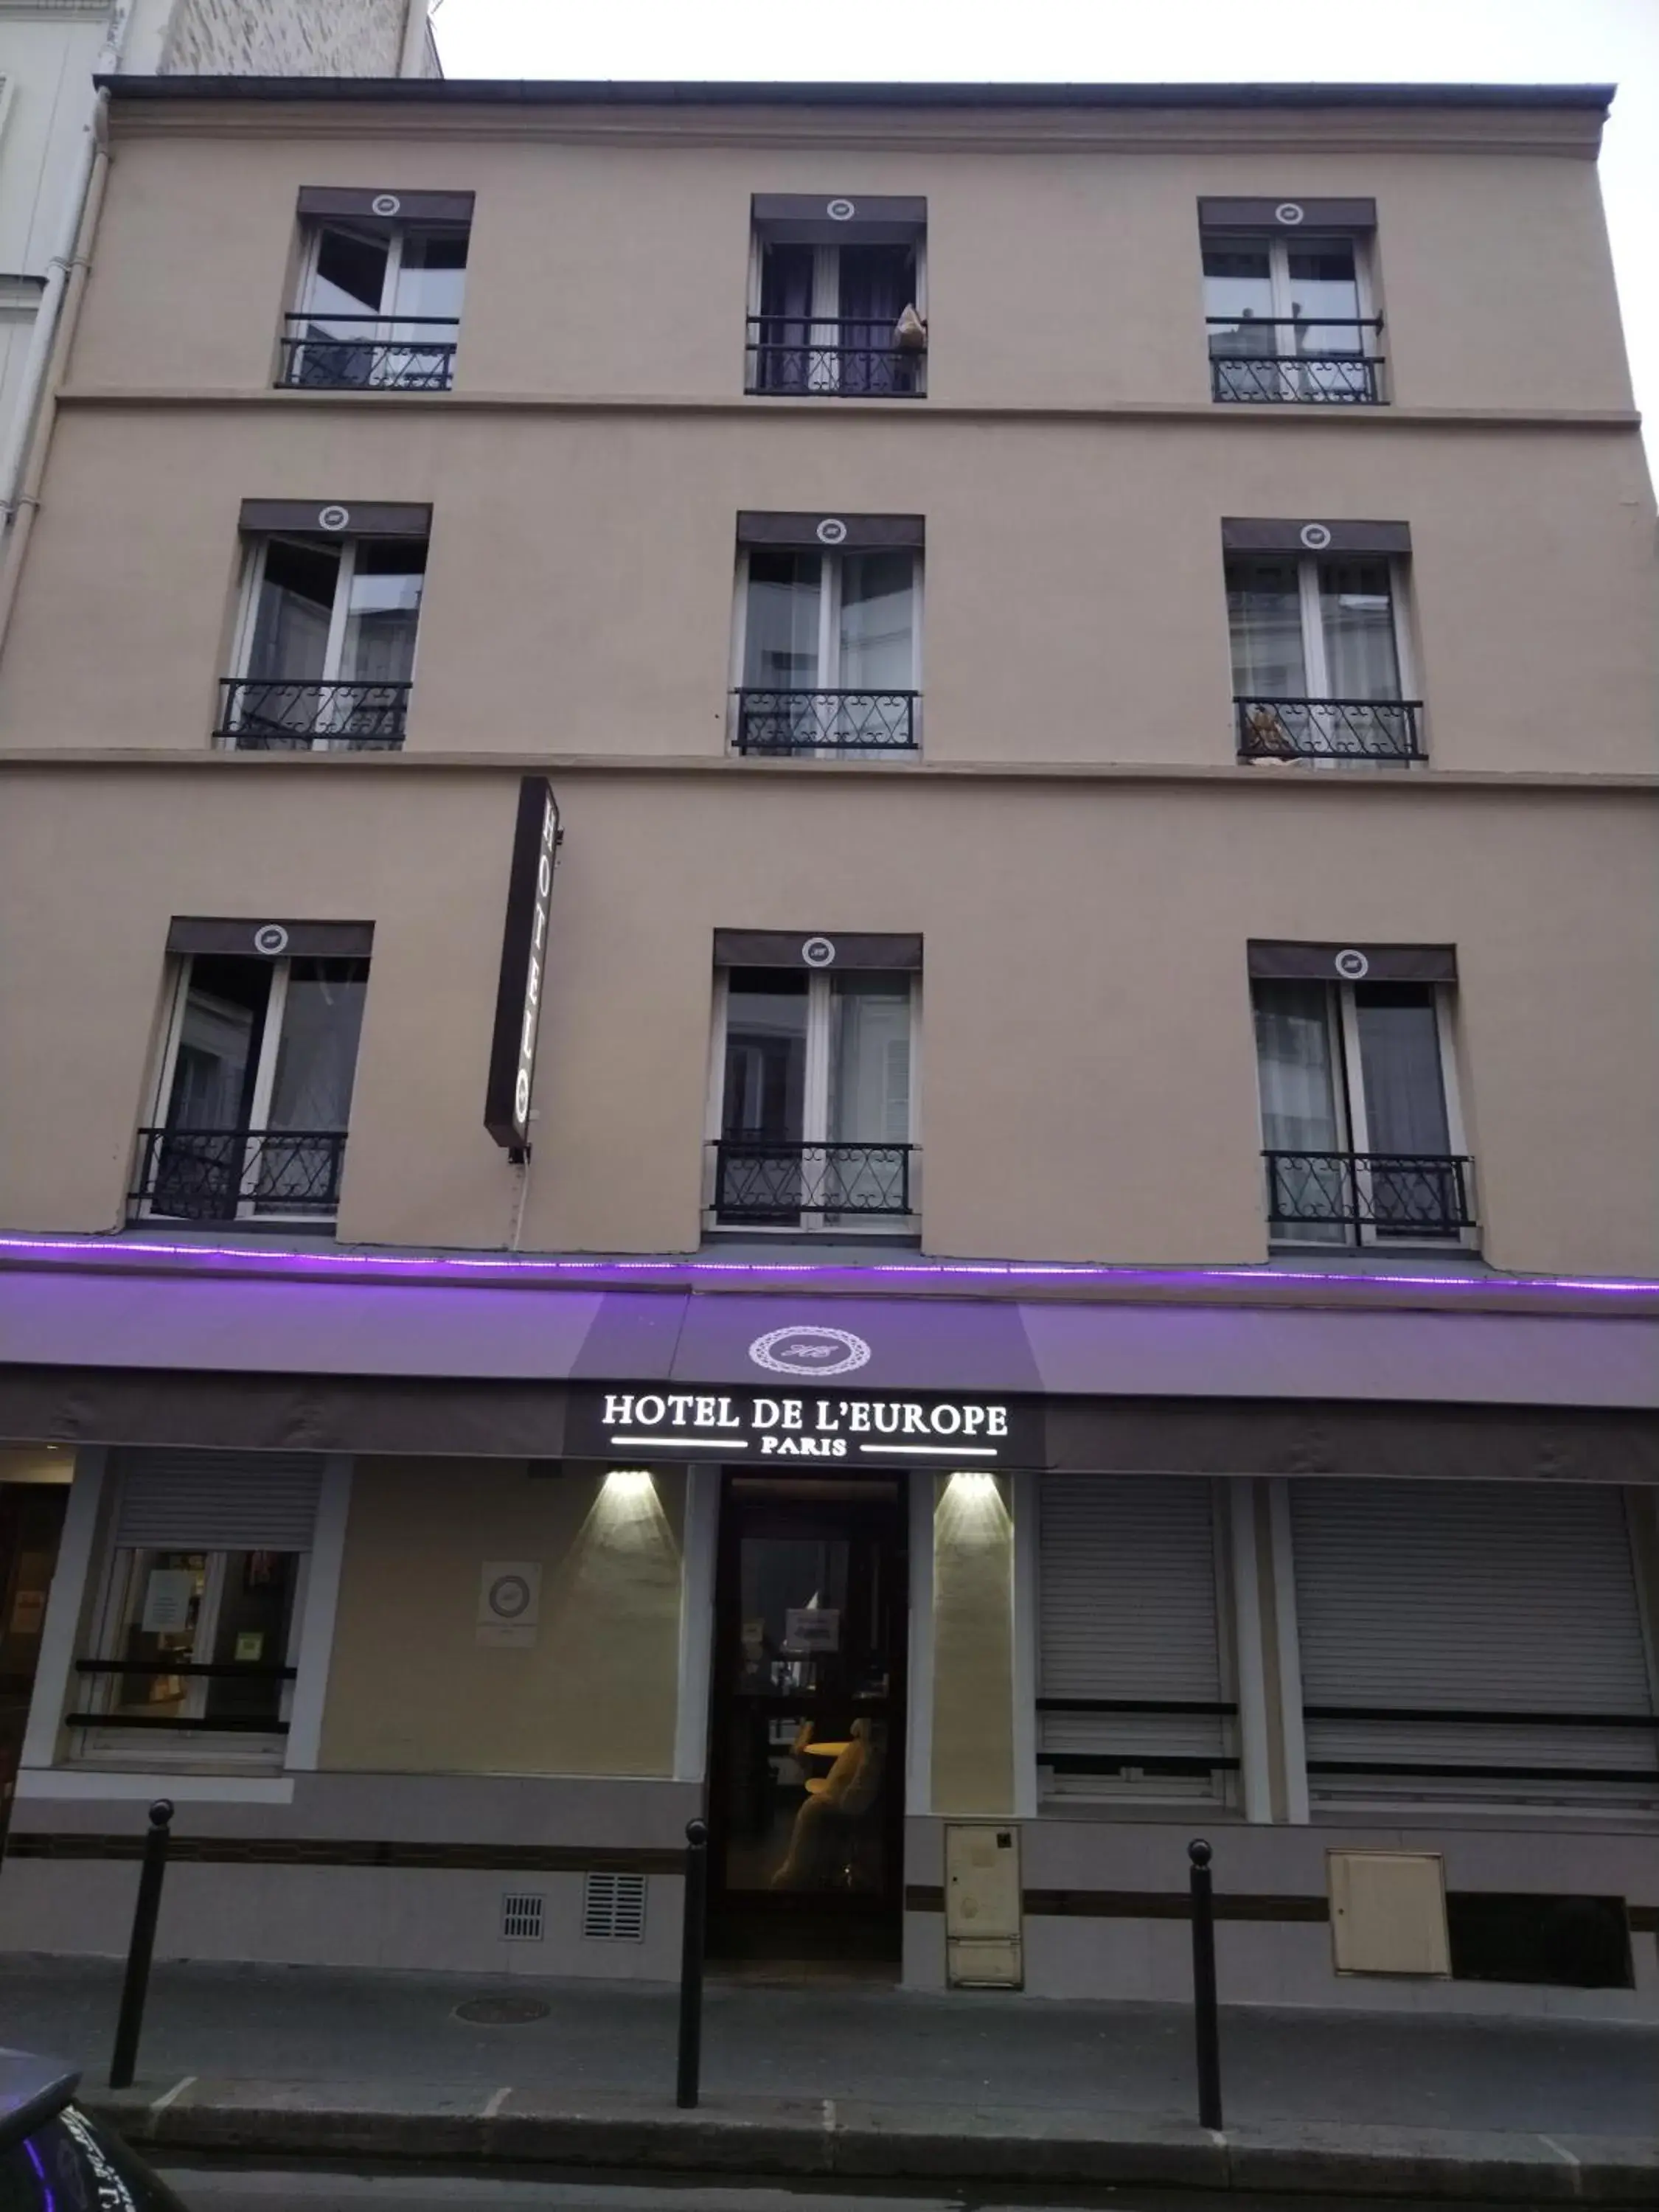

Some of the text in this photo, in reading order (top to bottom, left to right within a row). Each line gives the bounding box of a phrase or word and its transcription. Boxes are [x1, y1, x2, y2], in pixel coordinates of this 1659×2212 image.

[521, 799, 556, 1062] HOTEL
[601, 1394, 1009, 1436] HOTEL DE L'EUROPE
[760, 1436, 847, 1456] PARIS
